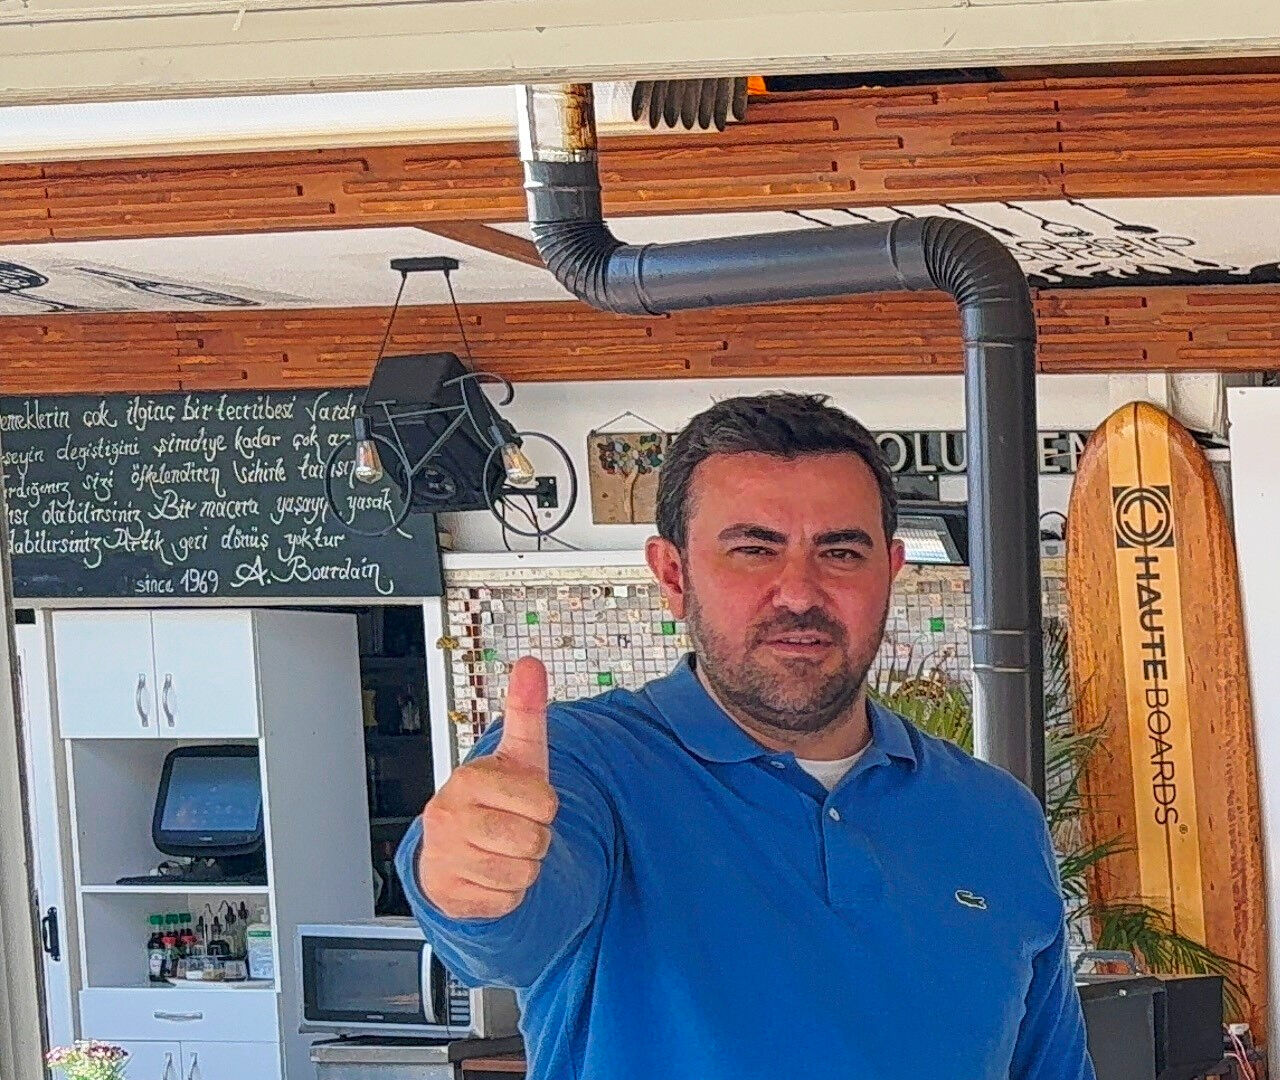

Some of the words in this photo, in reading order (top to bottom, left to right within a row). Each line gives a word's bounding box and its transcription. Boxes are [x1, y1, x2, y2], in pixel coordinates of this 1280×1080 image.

[0, 399, 71, 431] emeklerin
[134, 574, 175, 594] since
[180, 568, 219, 594] 1969
